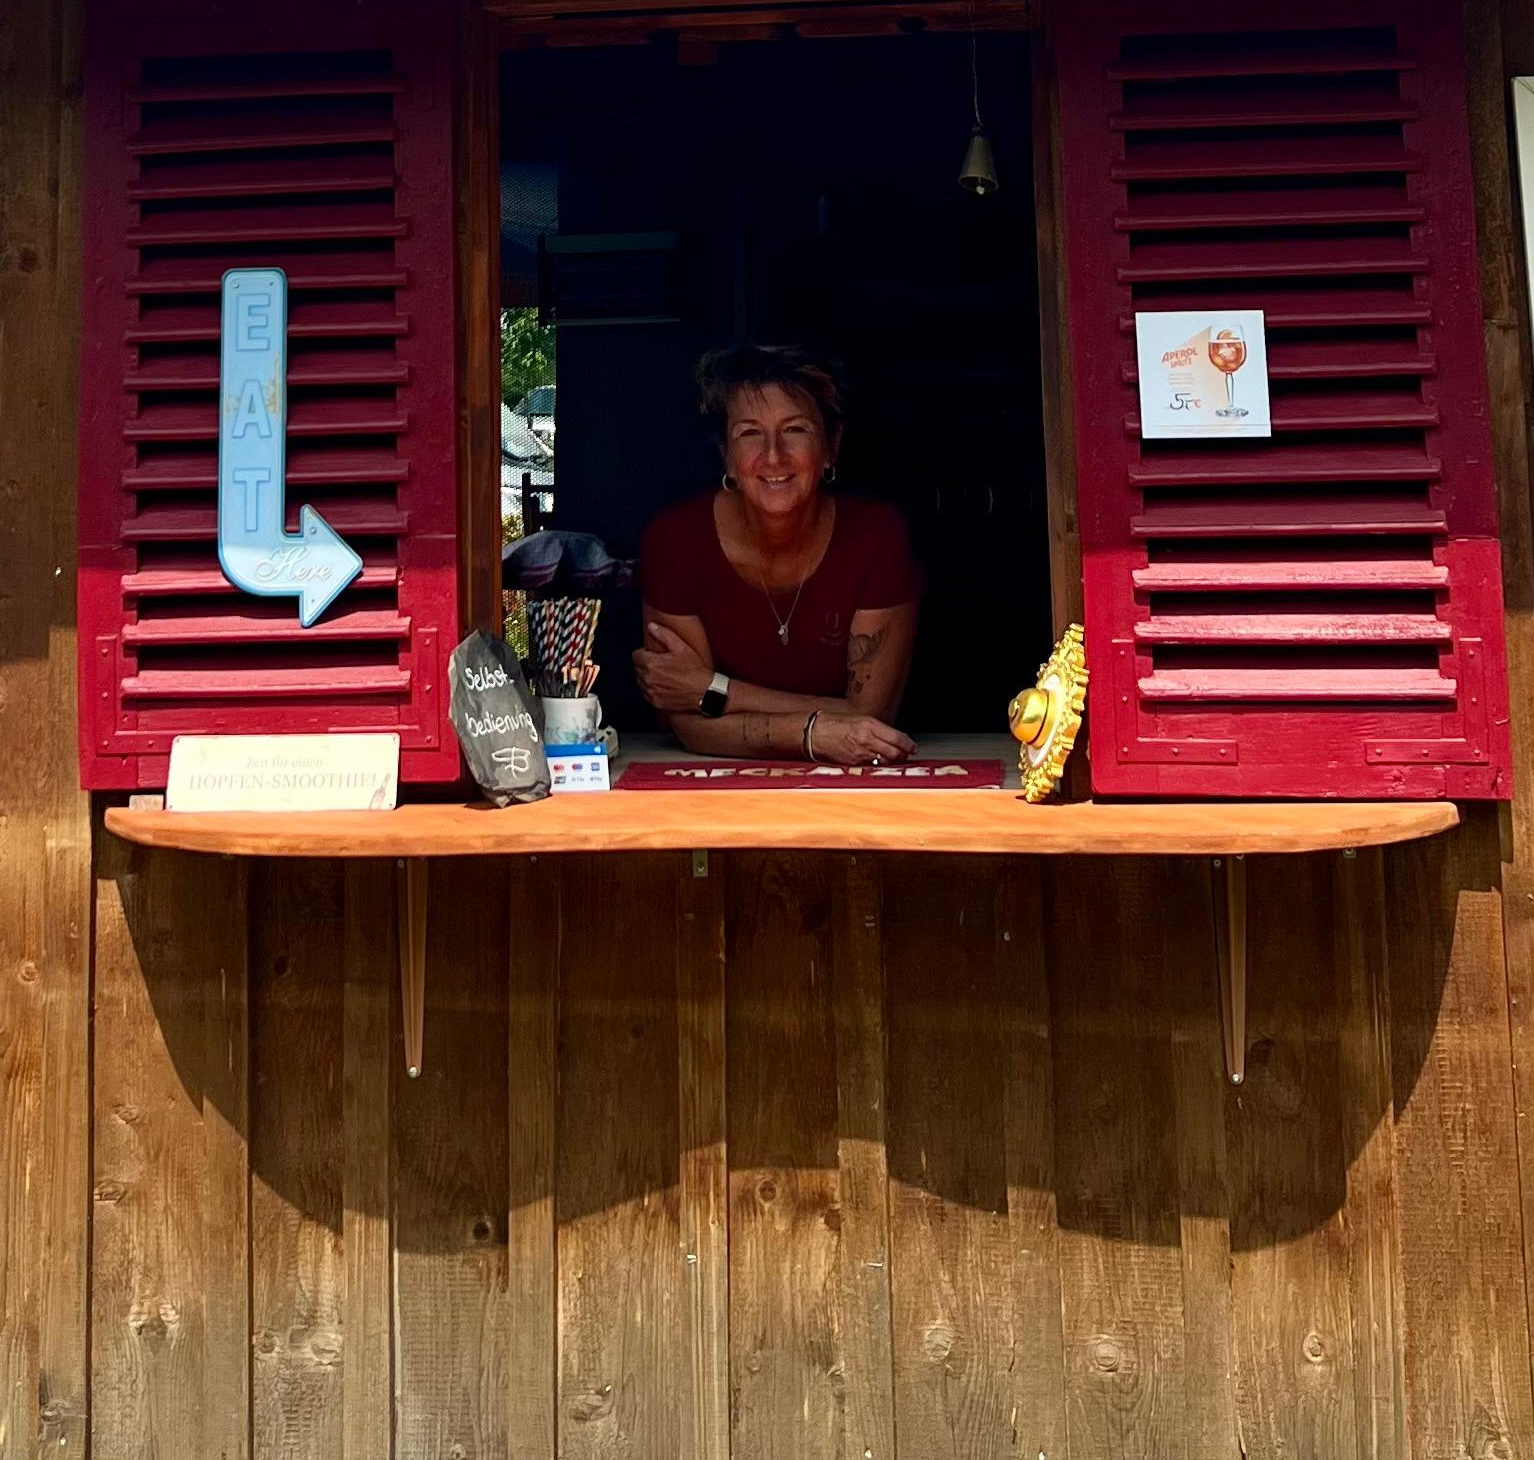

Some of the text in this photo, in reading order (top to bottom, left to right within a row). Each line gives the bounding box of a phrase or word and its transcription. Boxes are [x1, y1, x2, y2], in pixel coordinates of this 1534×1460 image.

[232, 293, 273, 533] EAT
[256, 545, 333, 581] Here
[465, 710, 539, 742] bedienung
[245, 755, 269, 769] Zeit
[271, 754, 289, 769] für
